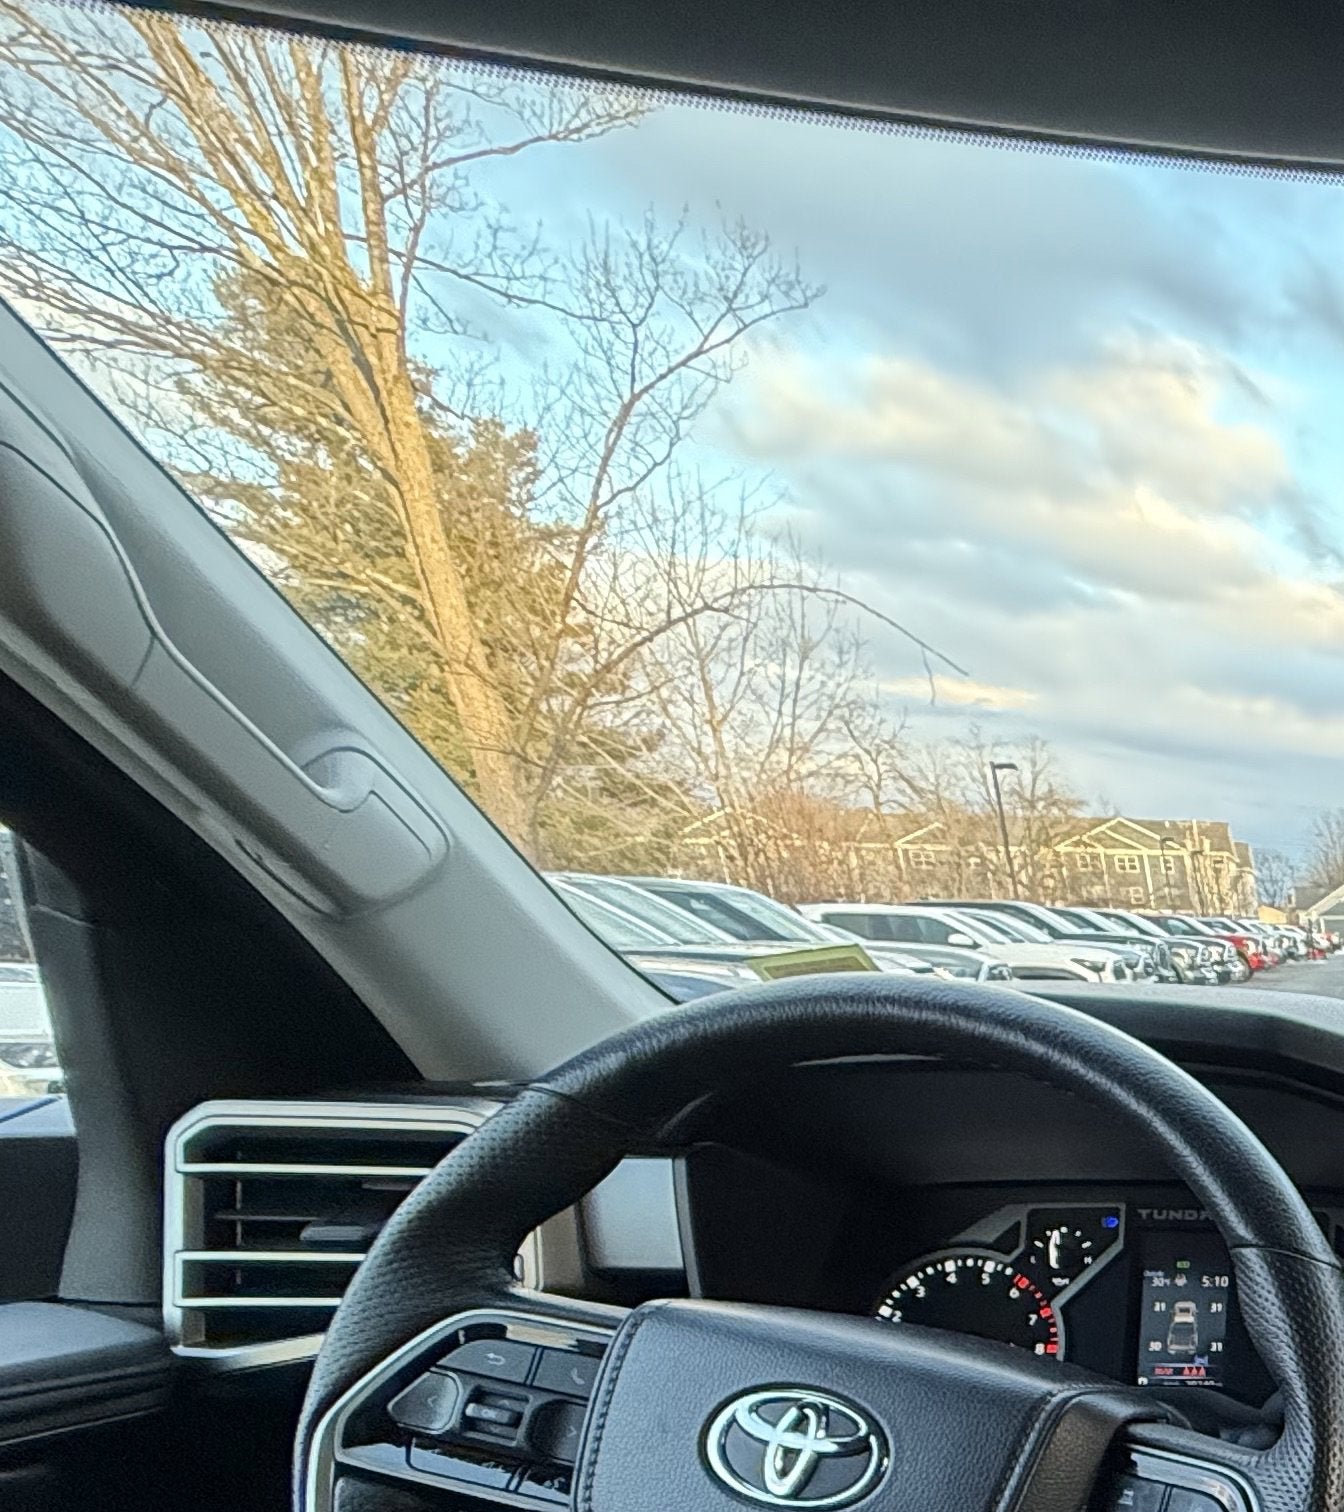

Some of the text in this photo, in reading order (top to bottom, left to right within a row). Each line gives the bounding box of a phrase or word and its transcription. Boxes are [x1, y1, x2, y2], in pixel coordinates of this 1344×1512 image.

[1137, 1208, 1213, 1220] TUNDR
[946, 1272, 958, 1284] 4
[981, 1273, 991, 1285] 5
[1201, 1275, 1229, 1287] 5:10
[915, 1285, 926, 1298] 3
[1009, 1288, 1020, 1299] 6
[1028, 1314, 1038, 1326] 7
[1034, 1343, 1046, 1355] 8
